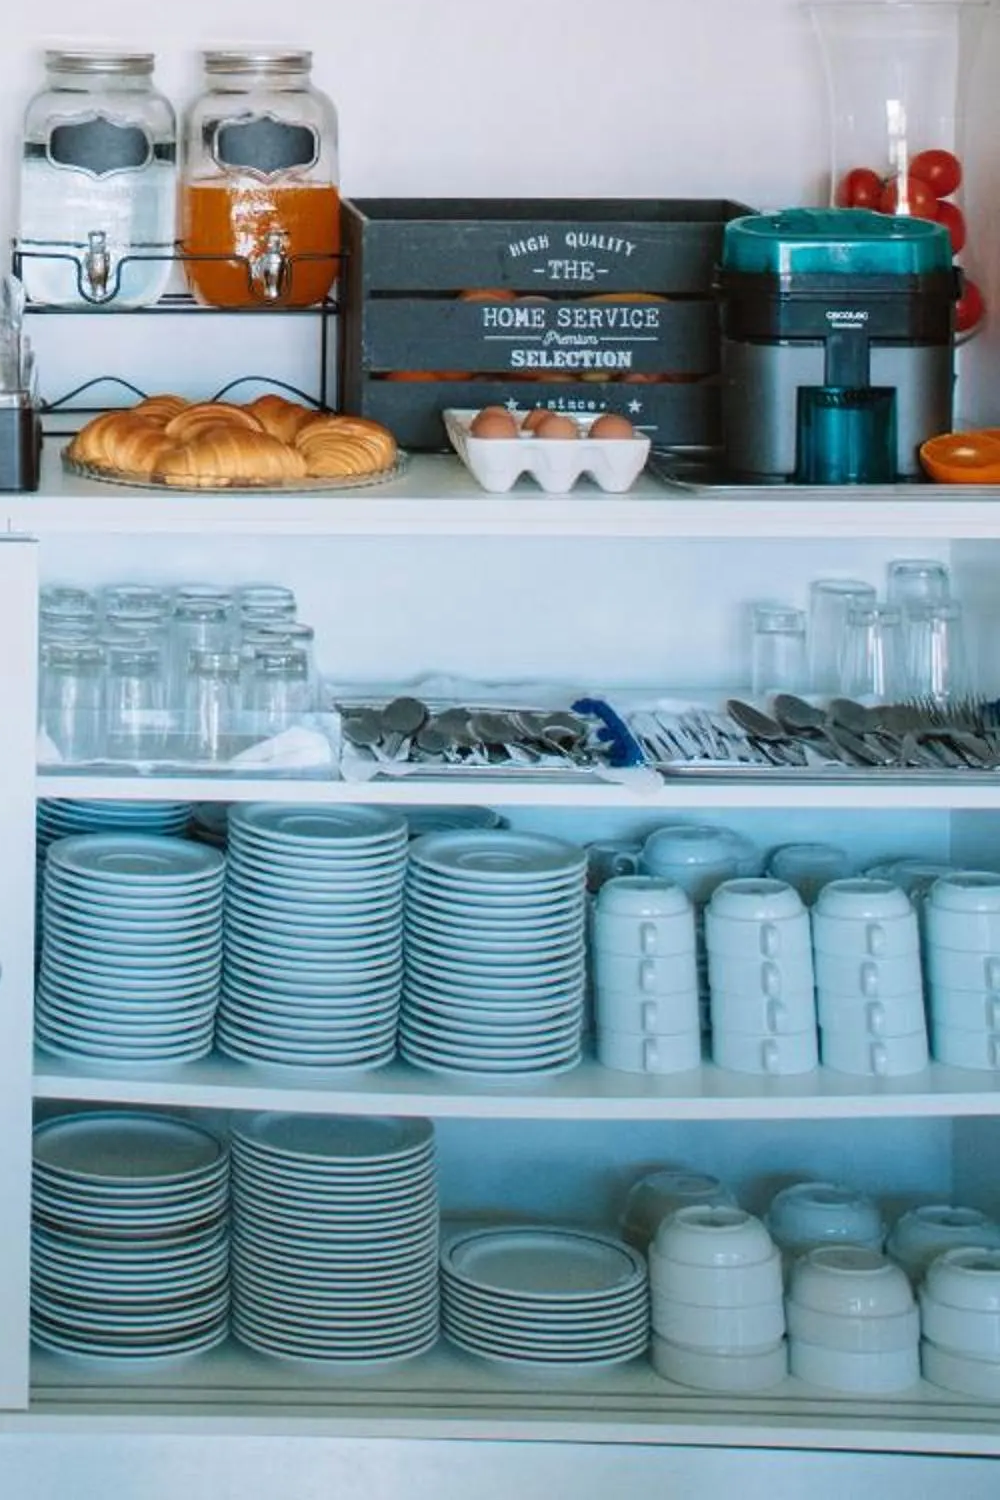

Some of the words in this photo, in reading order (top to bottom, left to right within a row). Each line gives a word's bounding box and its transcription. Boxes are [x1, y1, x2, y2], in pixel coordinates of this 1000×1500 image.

[509, 234, 549, 257] HIGH
[565, 232, 637, 257] QUALITY
[483, 308, 545, 328] HOME
[557, 308, 660, 329] SERVICE
[542, 329, 599, 346] Premium
[510, 351, 632, 368] SELECTION
